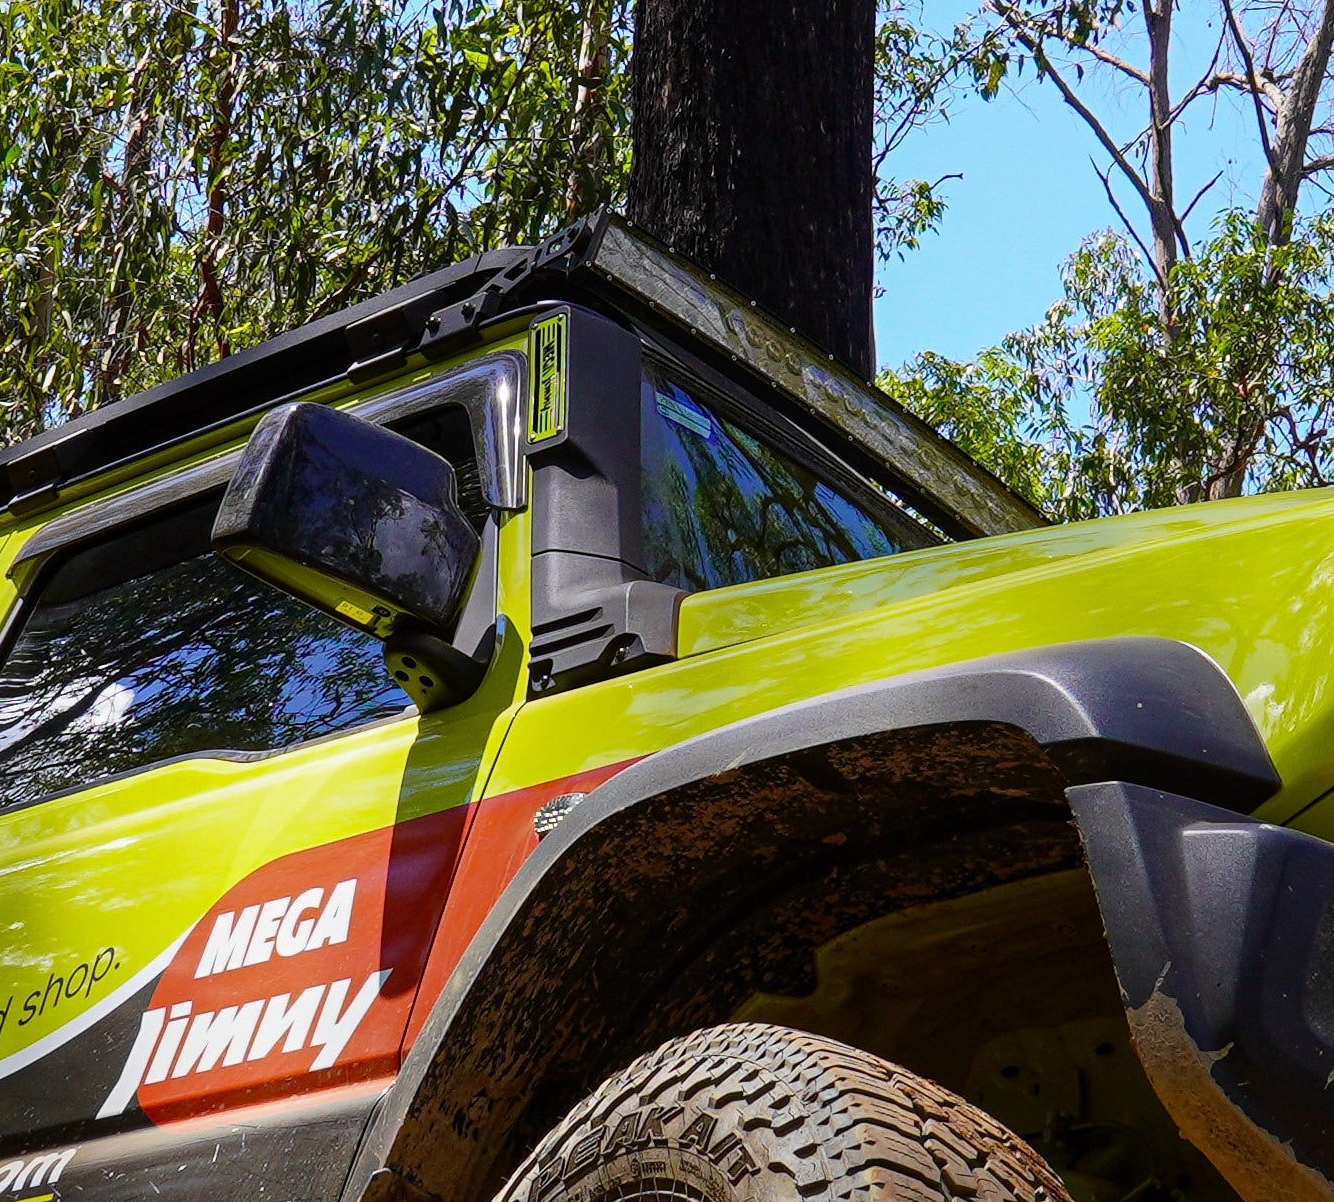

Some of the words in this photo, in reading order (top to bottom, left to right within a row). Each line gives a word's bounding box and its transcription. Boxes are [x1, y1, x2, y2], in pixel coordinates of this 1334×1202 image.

[193, 878, 358, 980] MEGA
[17, 946, 121, 1026] shop.
[95, 968, 394, 1120] Jimny
